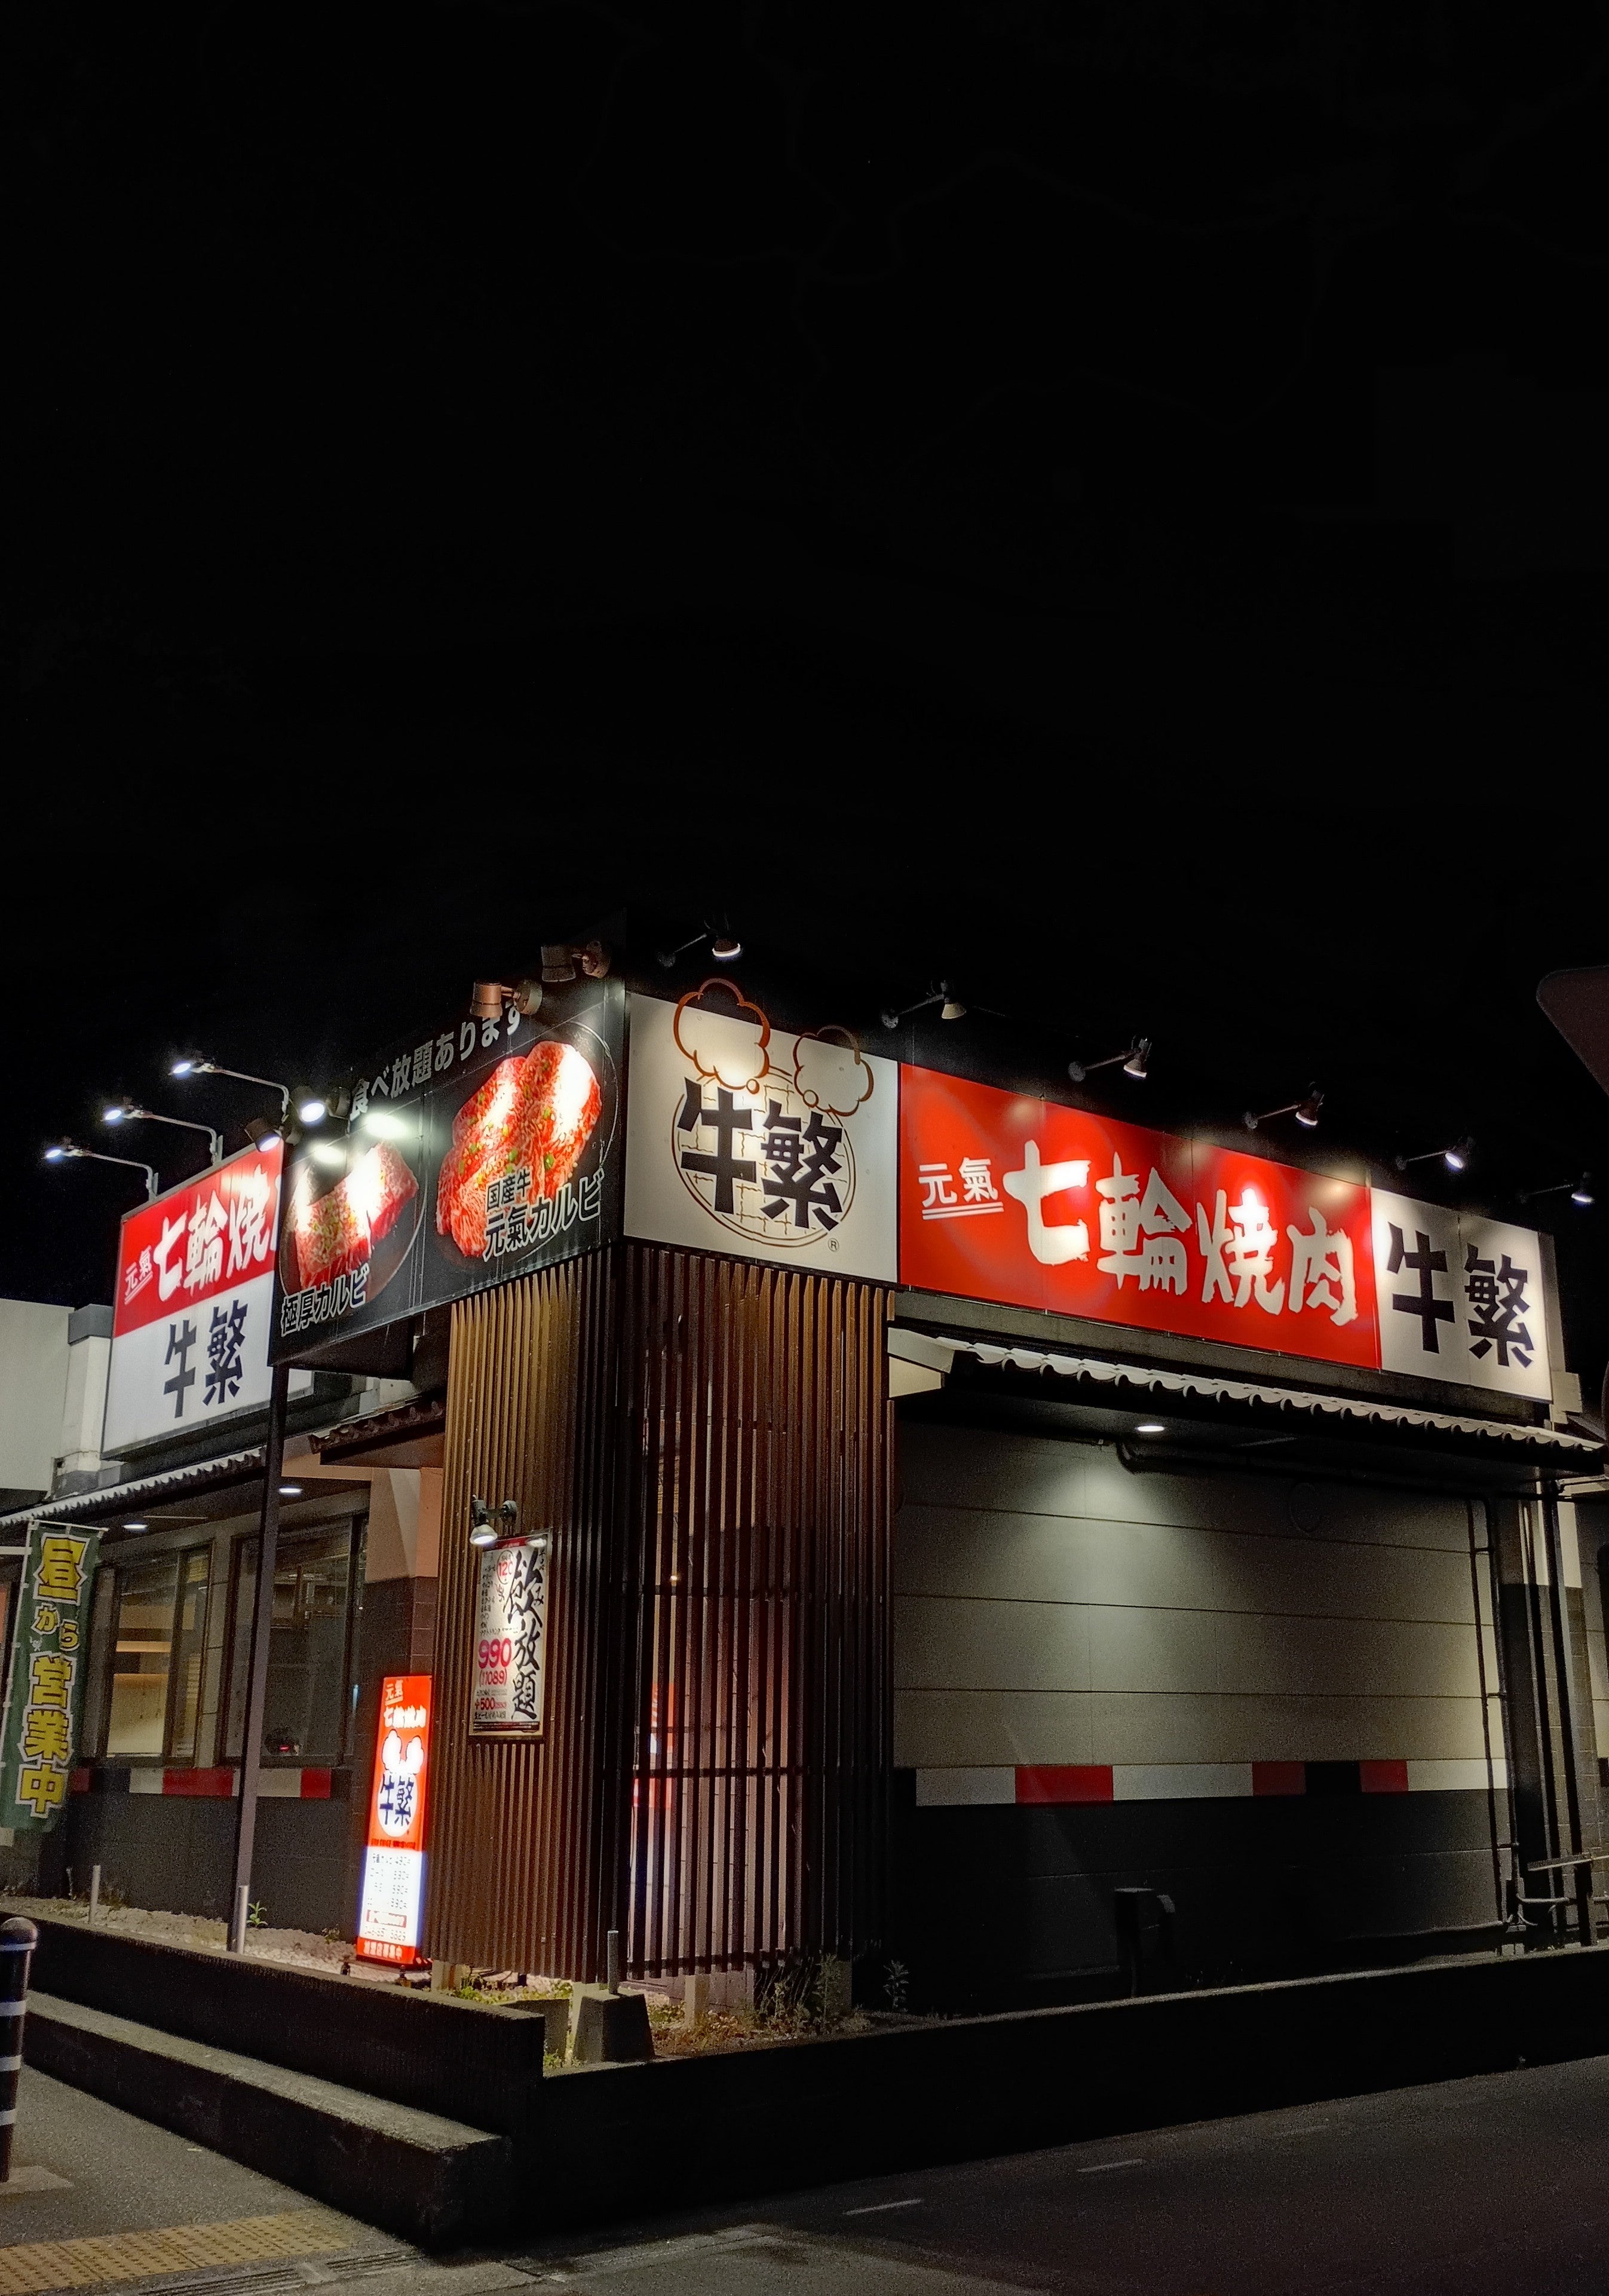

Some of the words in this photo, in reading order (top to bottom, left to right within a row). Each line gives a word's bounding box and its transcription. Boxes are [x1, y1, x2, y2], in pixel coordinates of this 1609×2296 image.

[485, 1165, 533, 1215] 国産牛
[677, 1076, 843, 1232] 牛繁
[483, 1167, 605, 1263] 元氣カルビ
[1002, 1139, 1359, 1326] 七輪焼肉
[280, 1262, 370, 1337] 極厚カルビ
[1387, 1221, 1535, 1369] 牛繁
[163, 1299, 249, 1419] 牛繁
[16, 1532, 90, 1819] 昼から営業中
[479, 1637, 512, 1669] 990
[379, 1773, 414, 1826] 牛繁
